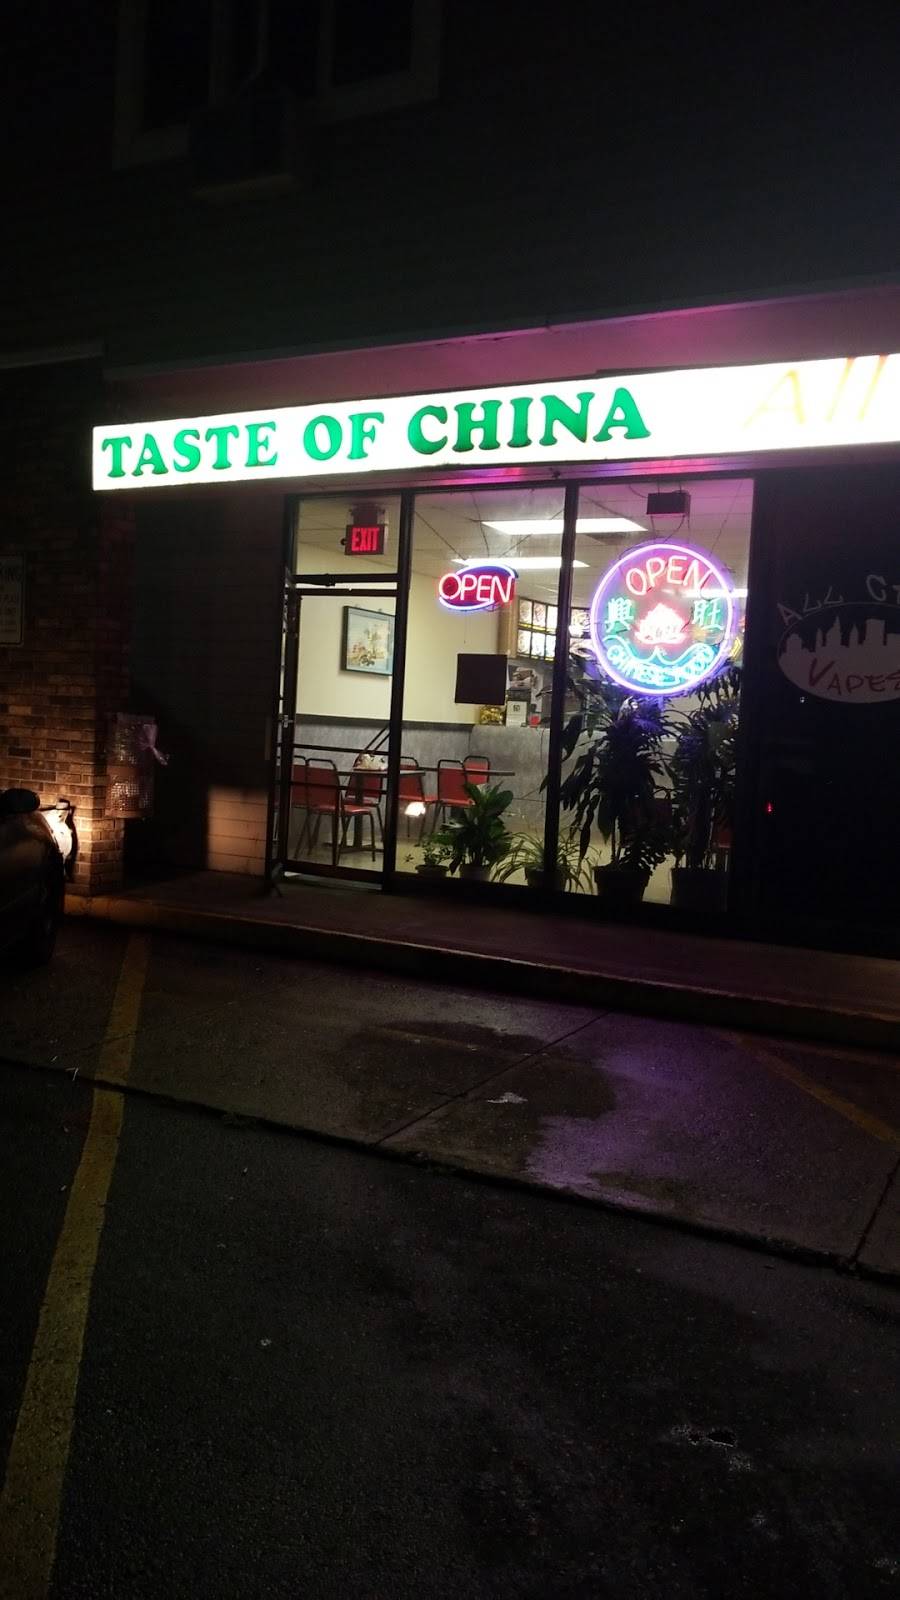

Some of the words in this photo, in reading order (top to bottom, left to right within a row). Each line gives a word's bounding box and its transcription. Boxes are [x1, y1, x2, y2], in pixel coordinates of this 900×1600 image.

[101, 421, 278, 478] TASTE
[303, 413, 384, 460] OF
[408, 387, 651, 455] CHINA
[351, 527, 380, 552] EXIT
[439, 573, 513, 603] OPEN
[625, 555, 714, 596] OPEN
